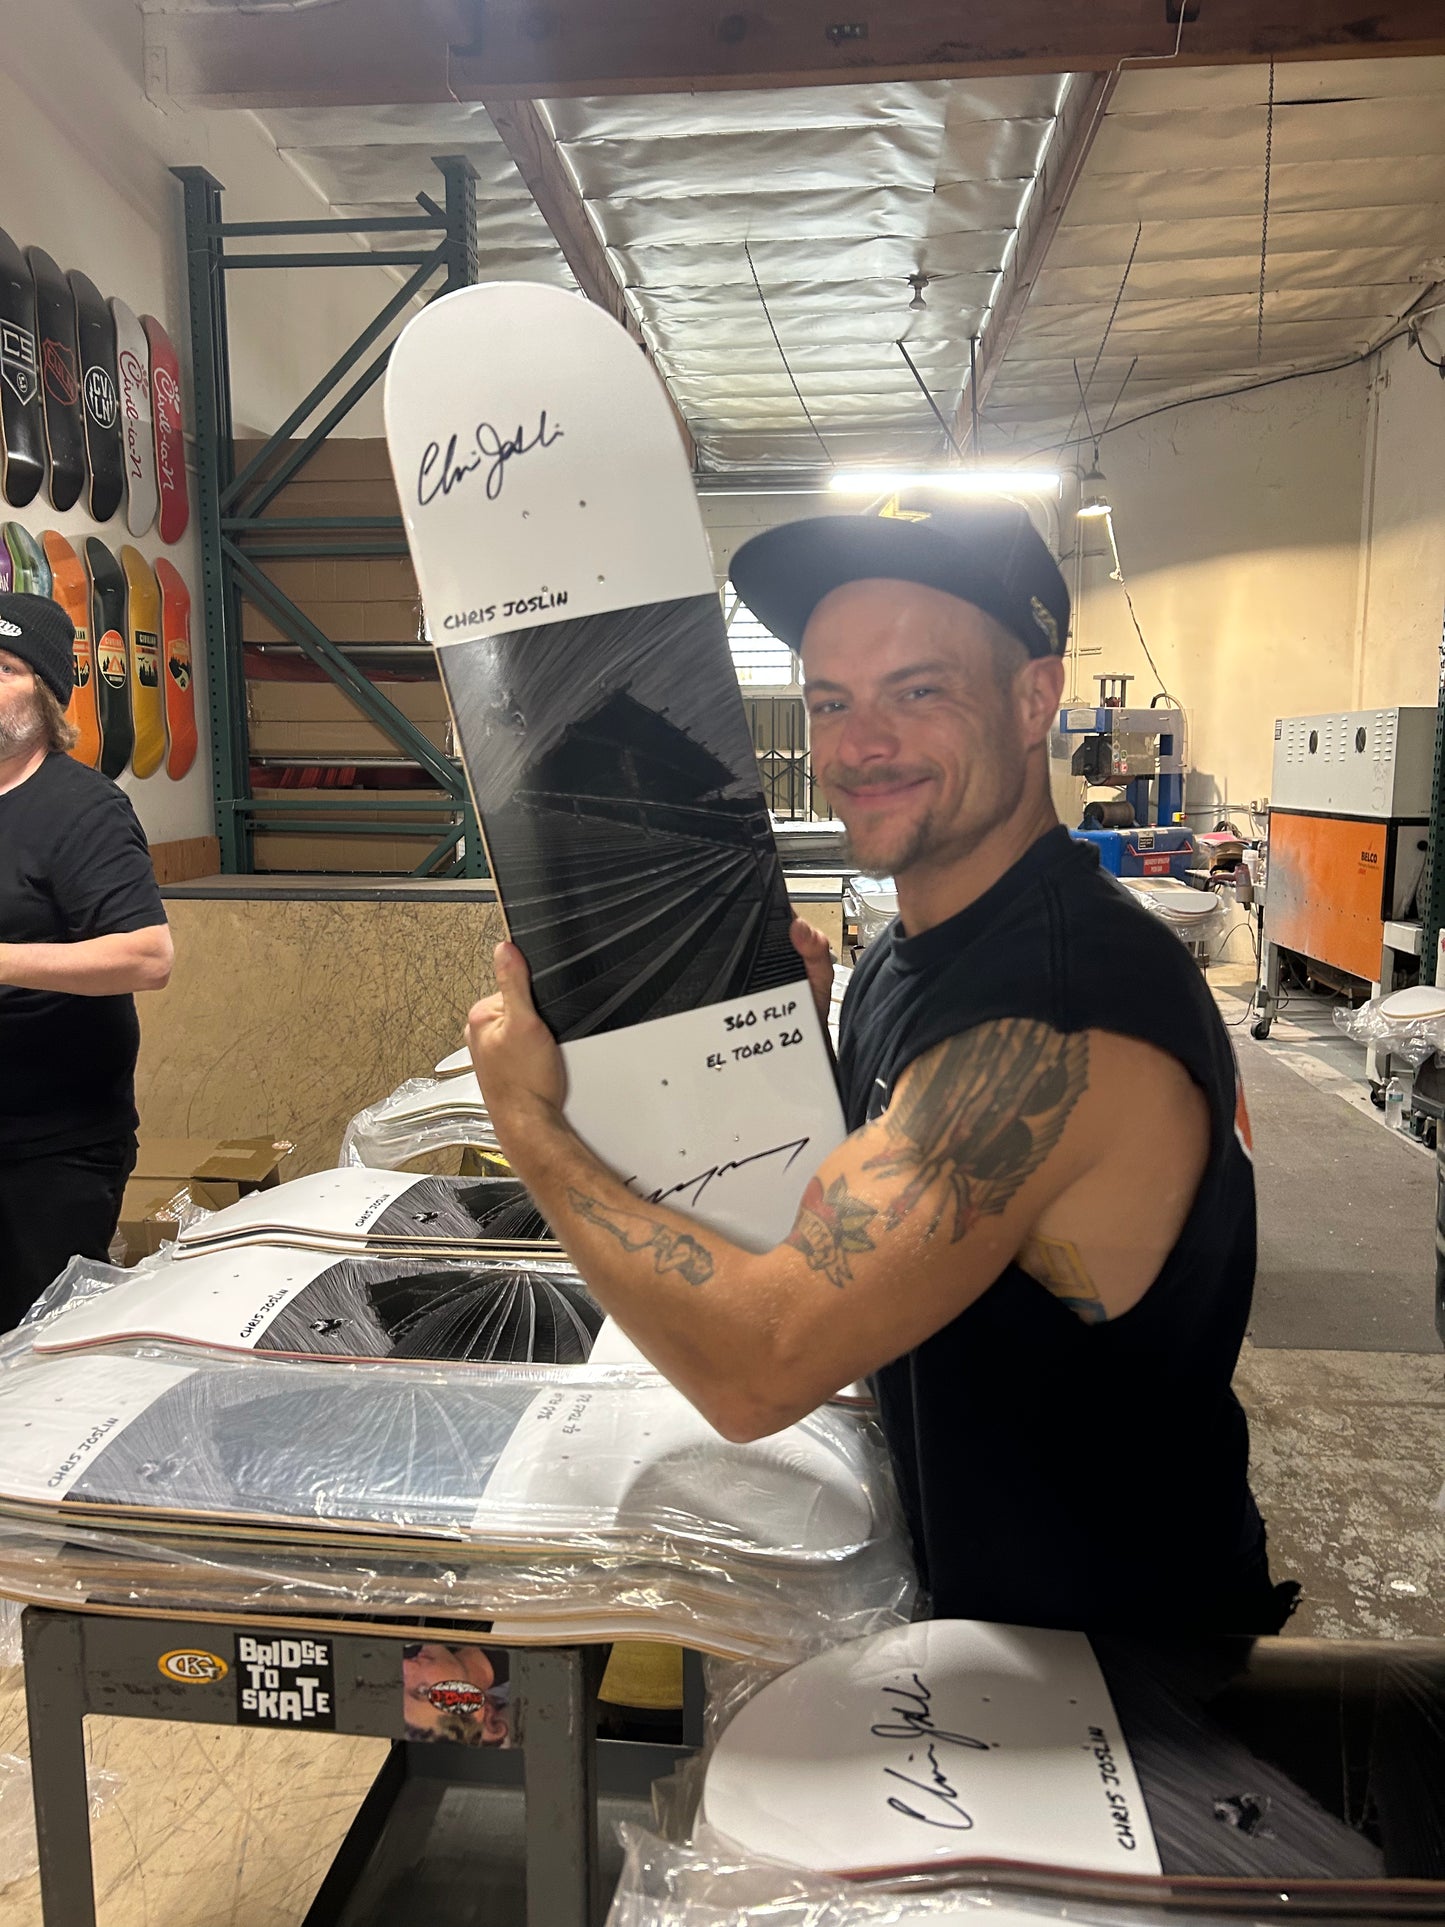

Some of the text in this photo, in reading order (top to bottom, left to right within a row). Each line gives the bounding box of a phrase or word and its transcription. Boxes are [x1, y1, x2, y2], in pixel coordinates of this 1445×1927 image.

[443, 591, 568, 629] CHRIS JOSLIN
[1361, 851, 1378, 864] BELCO
[723, 1001, 797, 1032] 360 FLIP
[706, 1028, 803, 1068] EL TORO 20
[355, 1210, 374, 1227] CHRIS
[240, 1289, 289, 1338] CHRIS JOSLIN
[47, 1417, 119, 1488] CHRIS JOSLIN
[240, 1637, 329, 1669] BRIDGE
[246, 1664, 279, 1690] TO
[242, 1676, 330, 1721] SKATE
[1088, 1725, 1136, 1850] CHRIS JOSLIN
